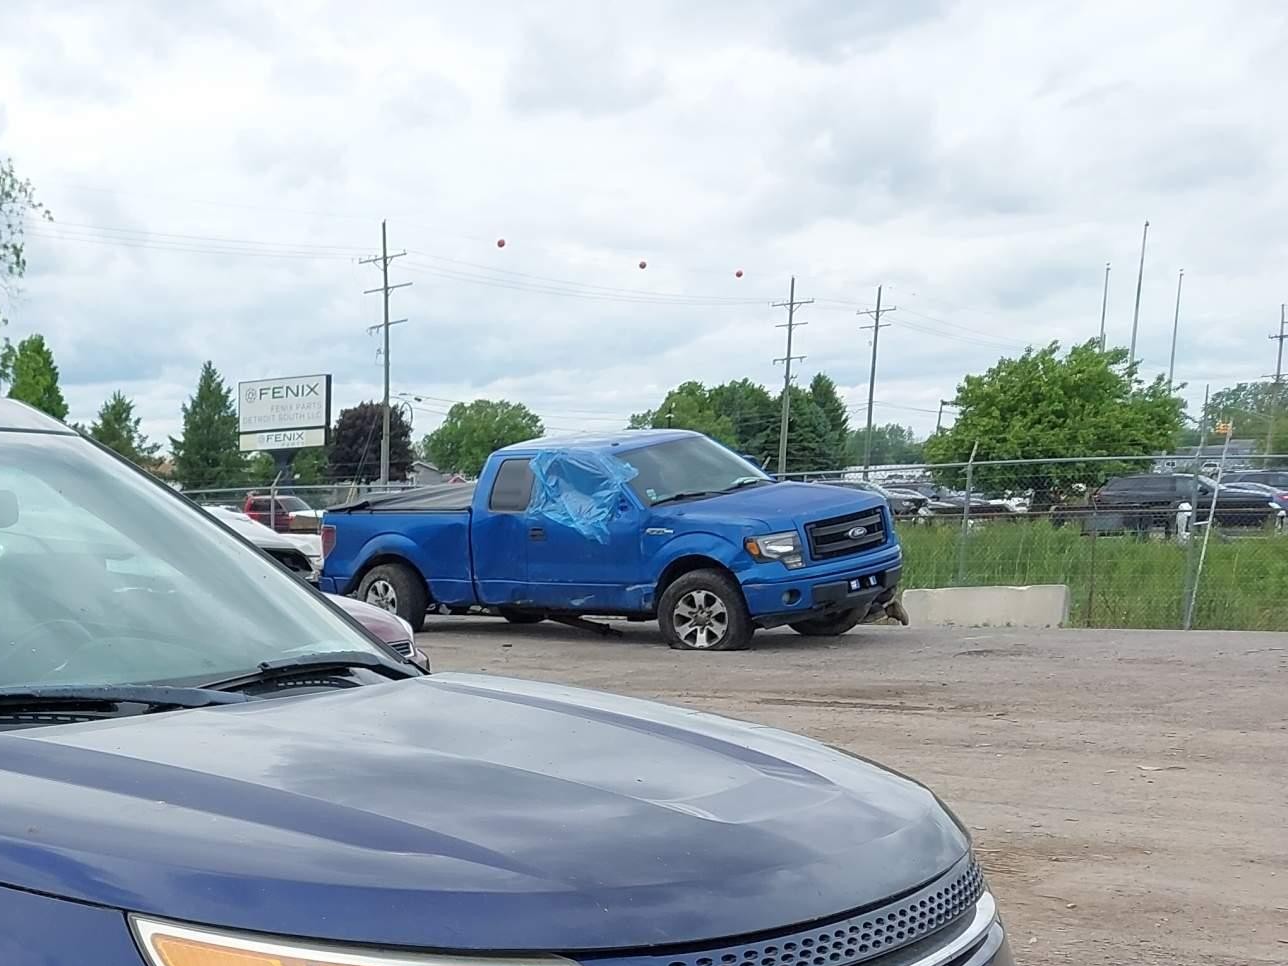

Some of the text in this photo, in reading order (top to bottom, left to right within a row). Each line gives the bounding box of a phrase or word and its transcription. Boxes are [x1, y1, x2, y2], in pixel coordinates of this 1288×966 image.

[259, 382, 320, 401] FENIX
[296, 401, 322, 411] PARTS
[266, 431, 305, 443] FENIX
